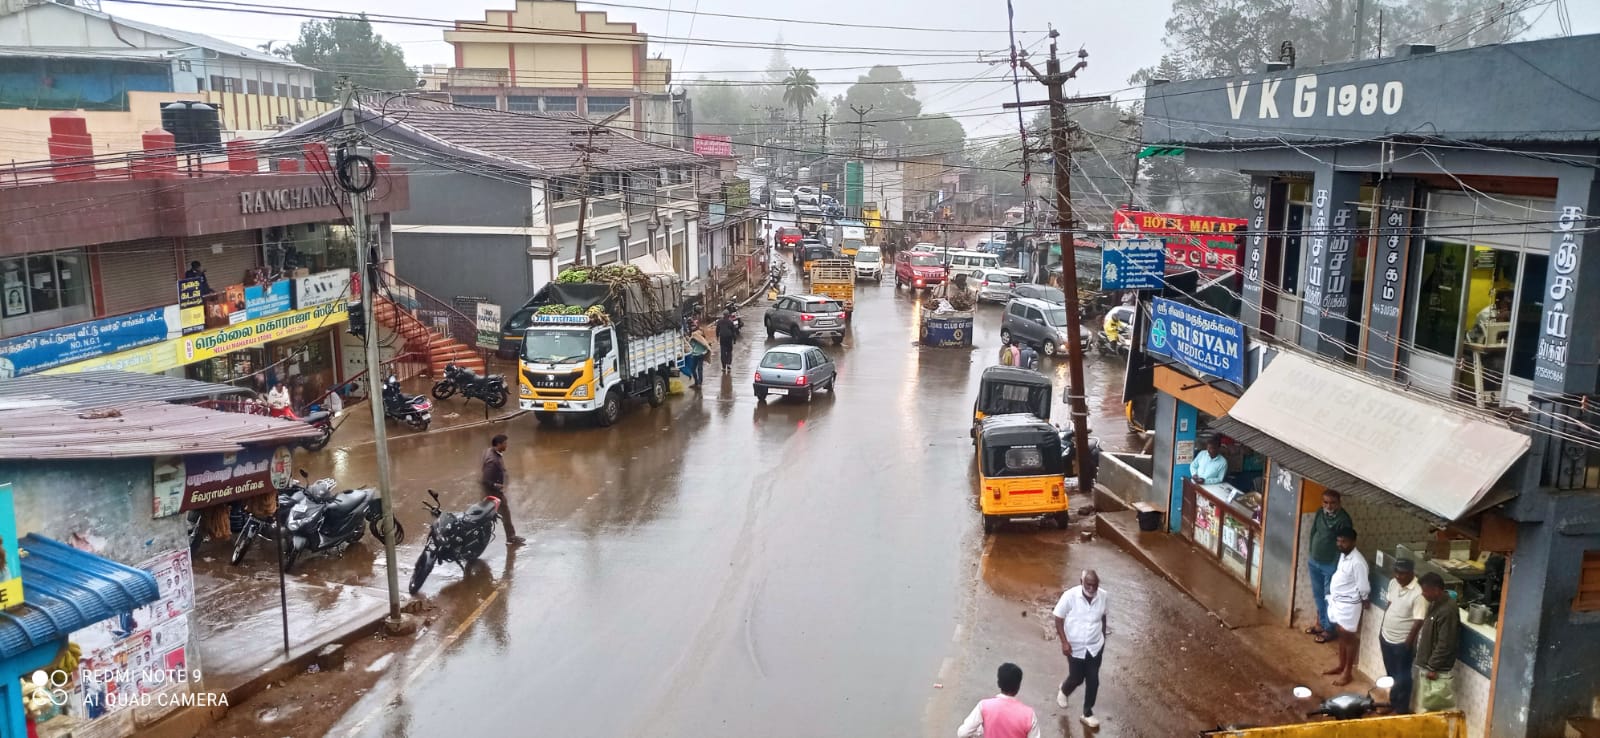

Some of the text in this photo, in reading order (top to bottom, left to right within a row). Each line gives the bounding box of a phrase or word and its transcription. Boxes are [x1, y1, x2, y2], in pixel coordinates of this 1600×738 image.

[1326, 81, 1404, 117] 1980
[1143, 216, 1184, 230] HOTEL
[195, 325, 253, 350] நெல்லை
[256, 313, 311, 334] மகாராஜா
[1170, 321, 1239, 359] SRI SIVAM
[1177, 340, 1230, 369] MEDICALS
